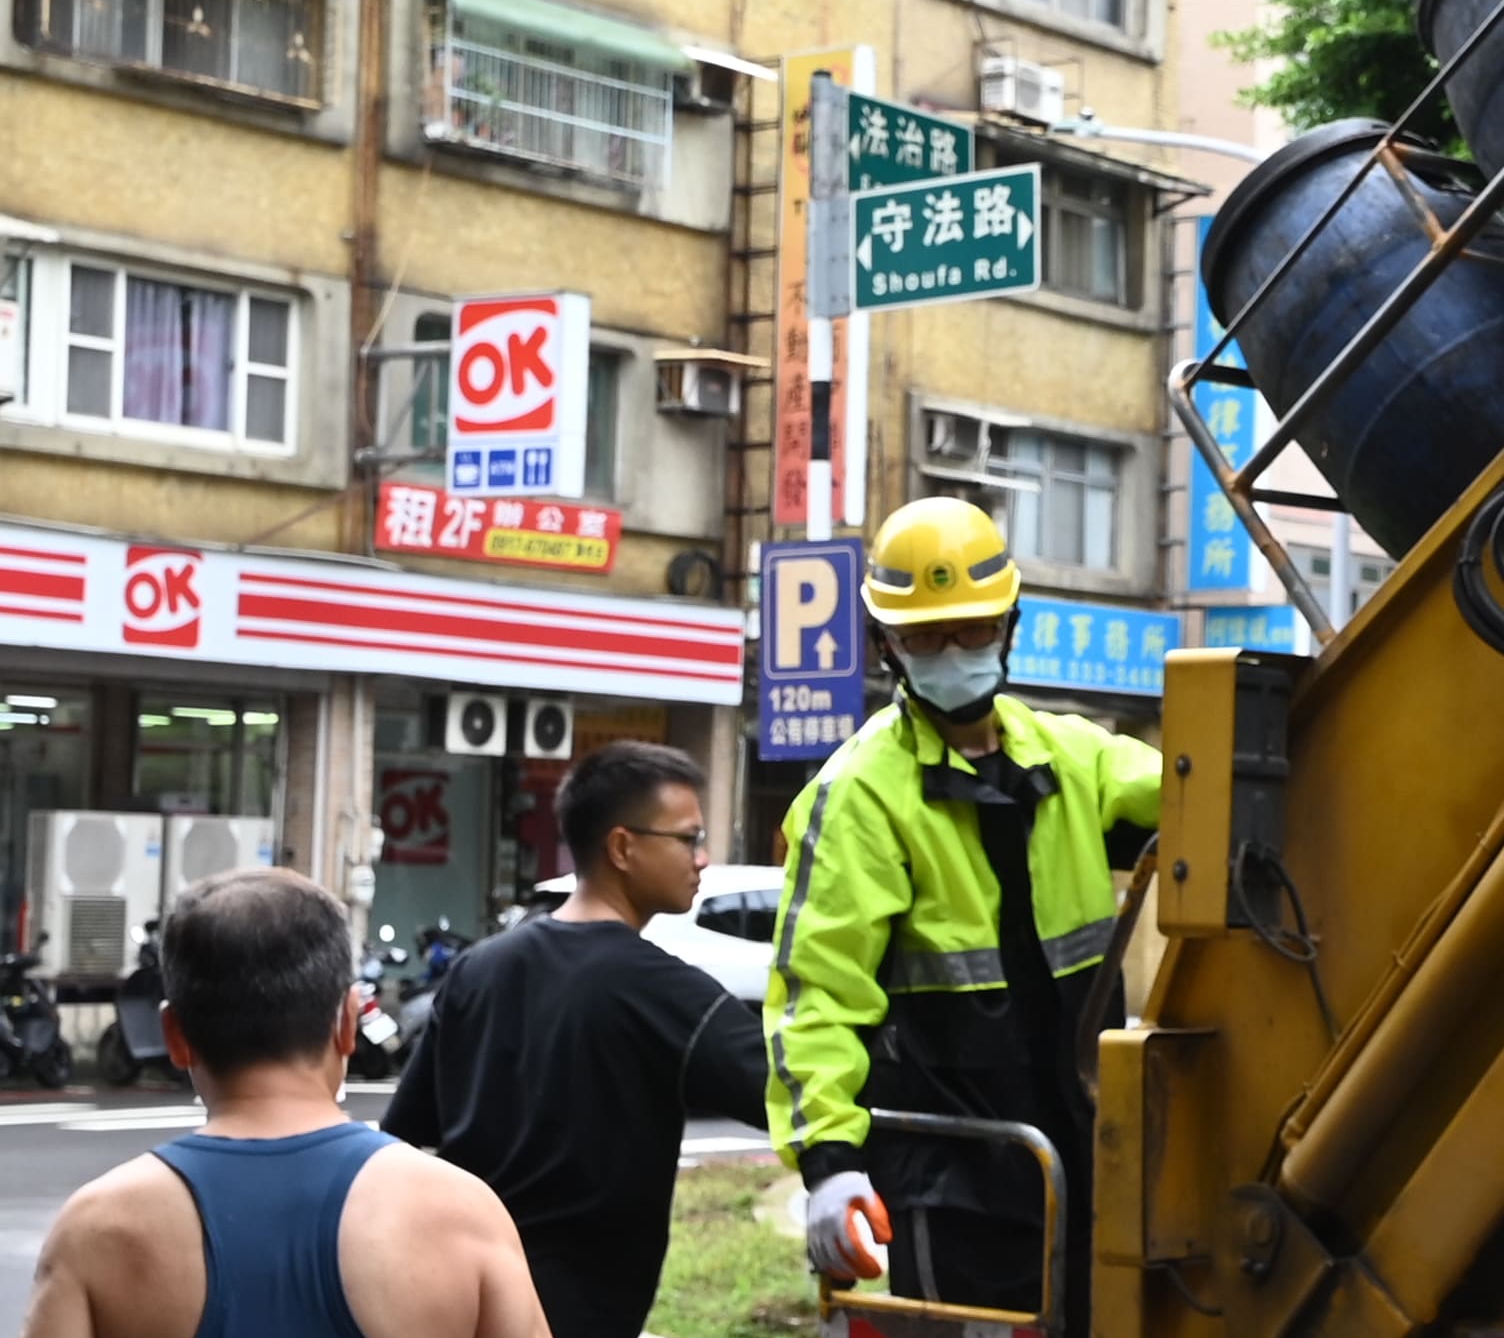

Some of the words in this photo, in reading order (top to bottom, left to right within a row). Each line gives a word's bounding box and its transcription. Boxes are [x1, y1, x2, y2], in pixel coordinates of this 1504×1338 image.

[860, 104, 958, 177] 法治路
[872, 183, 1016, 253] 守法路
[872, 264, 962, 296] Shoufa
[974, 256, 1018, 283] Rd.
[458, 325, 555, 407] OK
[125, 563, 201, 620] OK
[775, 557, 839, 669] P
[768, 684, 832, 713] 120m
[379, 782, 450, 842] OK
